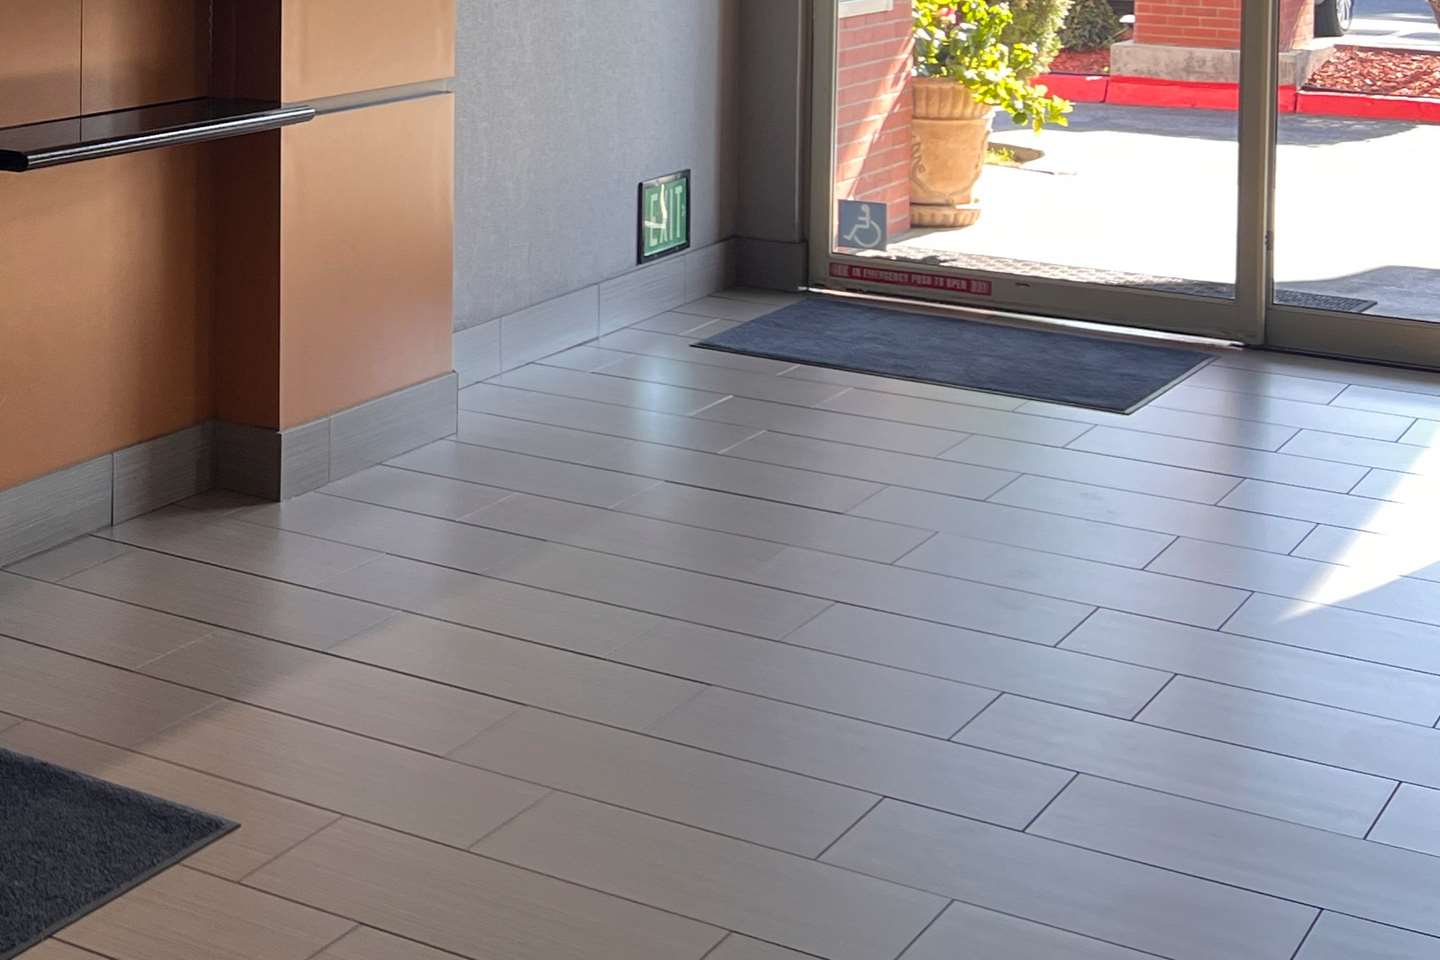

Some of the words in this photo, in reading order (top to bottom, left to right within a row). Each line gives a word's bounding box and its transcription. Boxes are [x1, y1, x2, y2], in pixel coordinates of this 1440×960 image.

[863, 268, 909, 282] EMERGENCY
[911, 273, 932, 286] PUSH
[946, 277, 967, 290] OPEN
